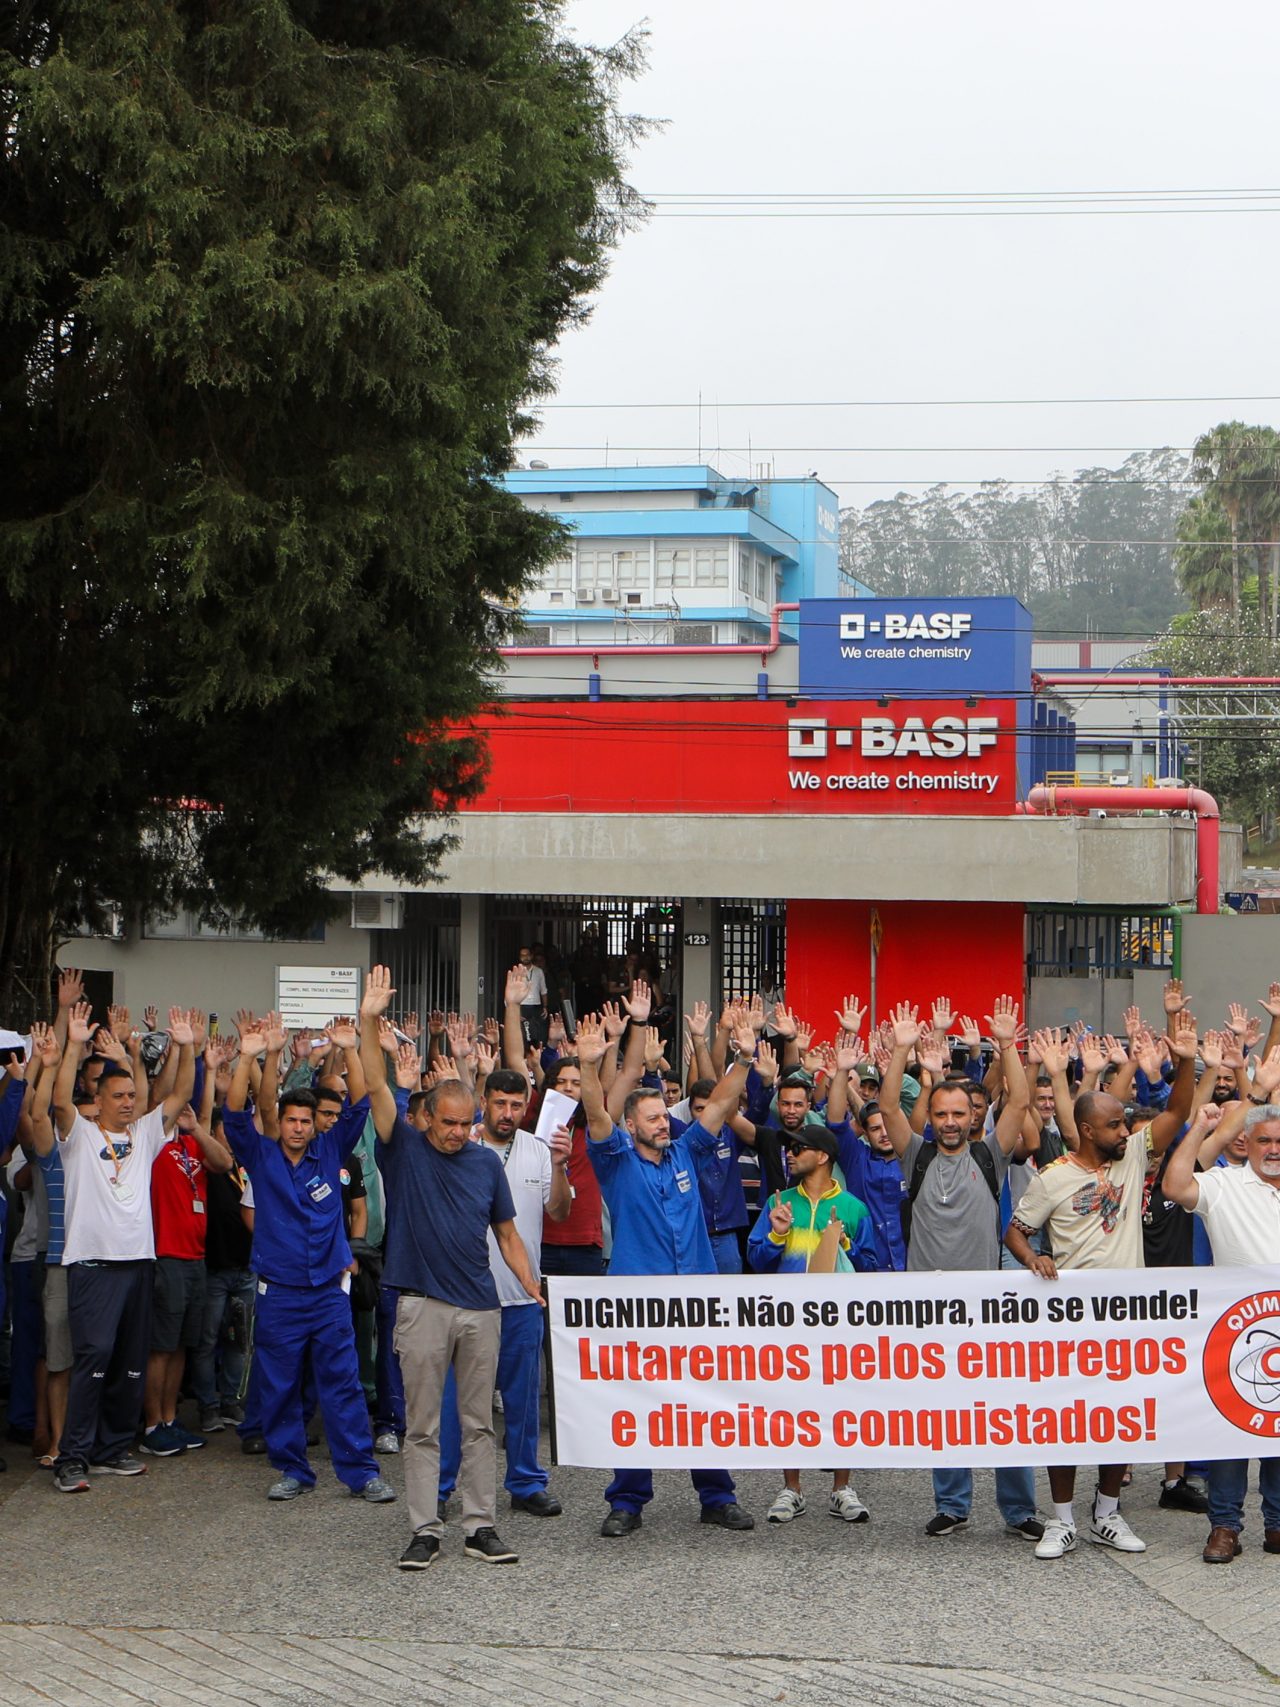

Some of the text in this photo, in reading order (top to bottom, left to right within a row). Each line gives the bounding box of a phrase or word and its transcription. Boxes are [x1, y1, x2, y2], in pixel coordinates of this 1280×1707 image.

[885, 613, 972, 640] BASF
[840, 646, 972, 661] We create chemistry
[861, 716, 999, 758] BASF
[788, 770, 999, 793] We create chemistry
[687, 935, 706, 945] 123
[564, 1288, 1198, 1329] DIGNIDADE: Não se compra, não se vende!
[578, 1336, 1187, 1385] Lutaremos pelos empregos
[612, 1397, 1157, 1451] e direitos conquistados!
